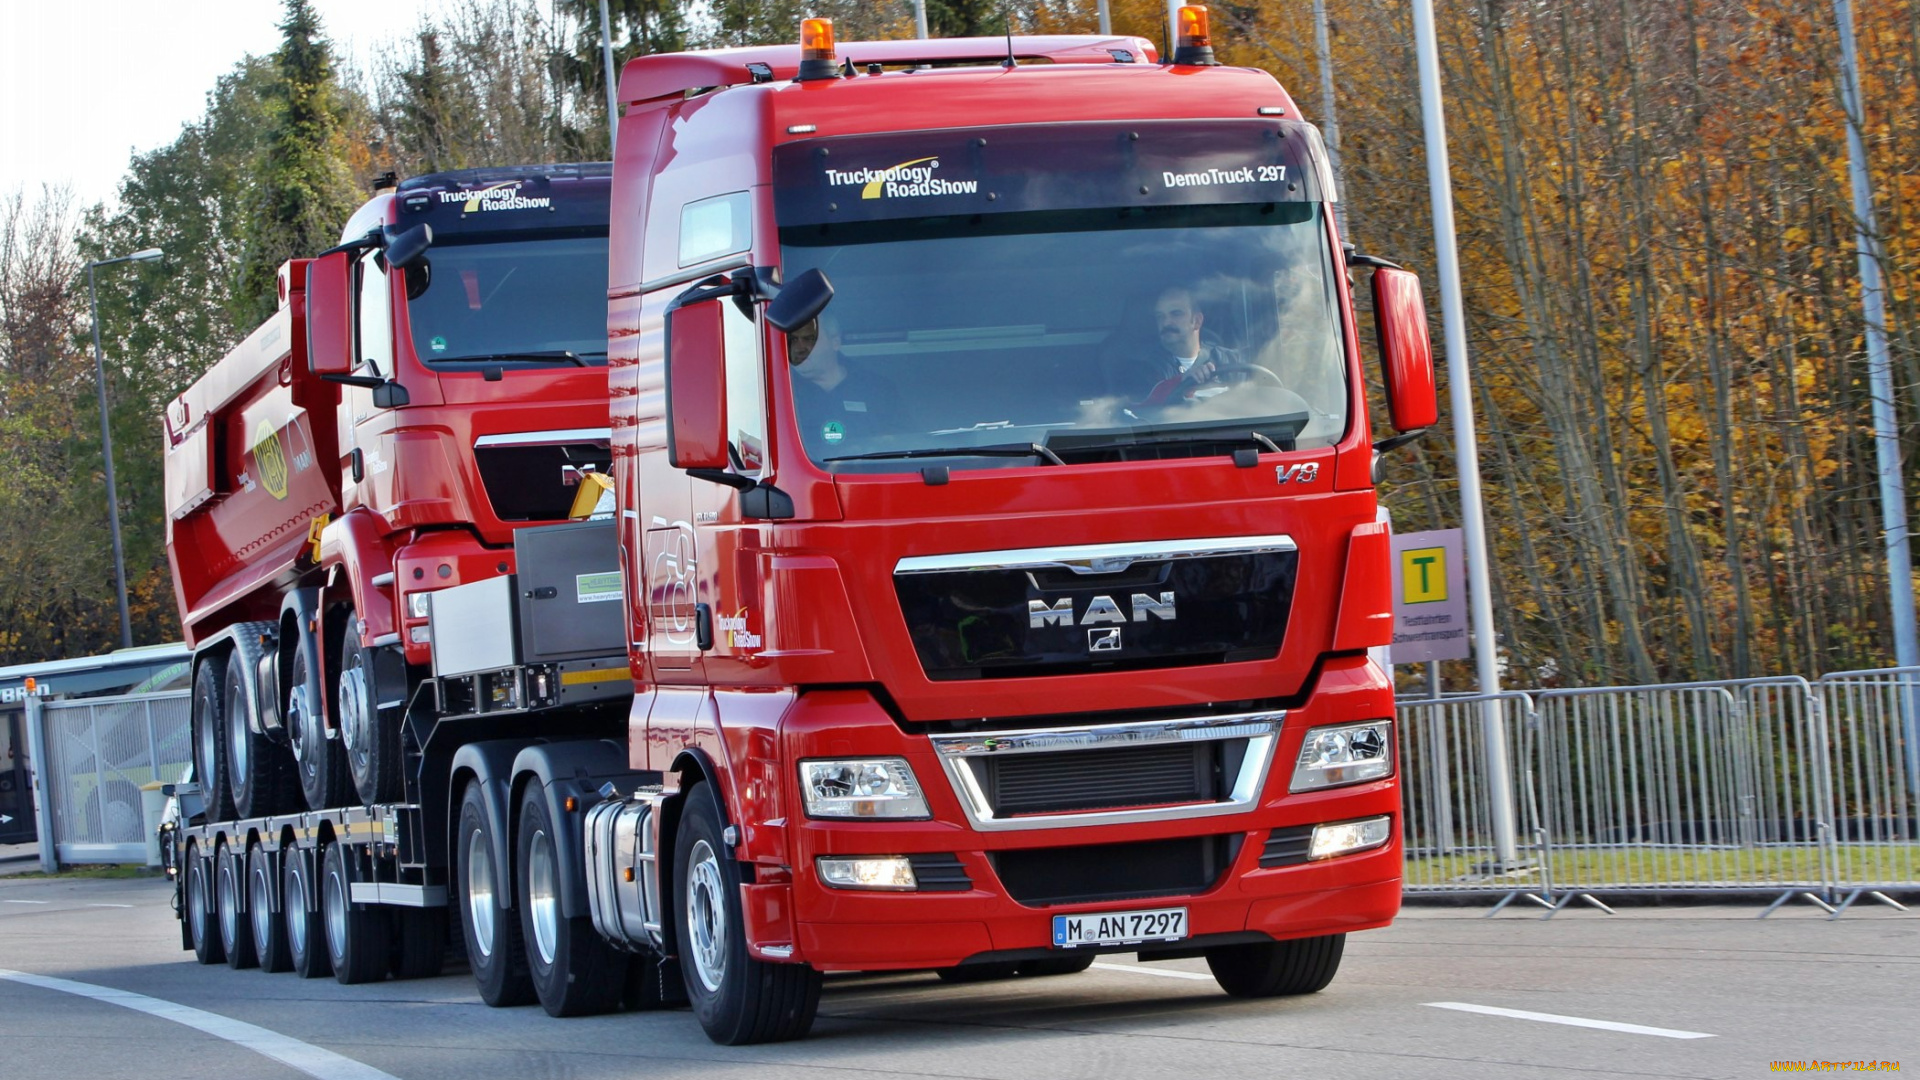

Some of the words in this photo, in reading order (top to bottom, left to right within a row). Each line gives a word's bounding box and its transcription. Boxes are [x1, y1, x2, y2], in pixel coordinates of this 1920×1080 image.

[1162, 166, 1256, 188] DemoTruck
[1257, 165, 1286, 182] 297
[886, 178, 978, 198] RoadShow
[482, 196, 550, 212] RoadShow
[1275, 461, 1320, 485] V8
[1411, 556, 1435, 593] T
[1028, 591, 1177, 629] MAN
[1402, 614, 1452, 627] Testfahrten
[733, 630, 762, 648] RoadShow
